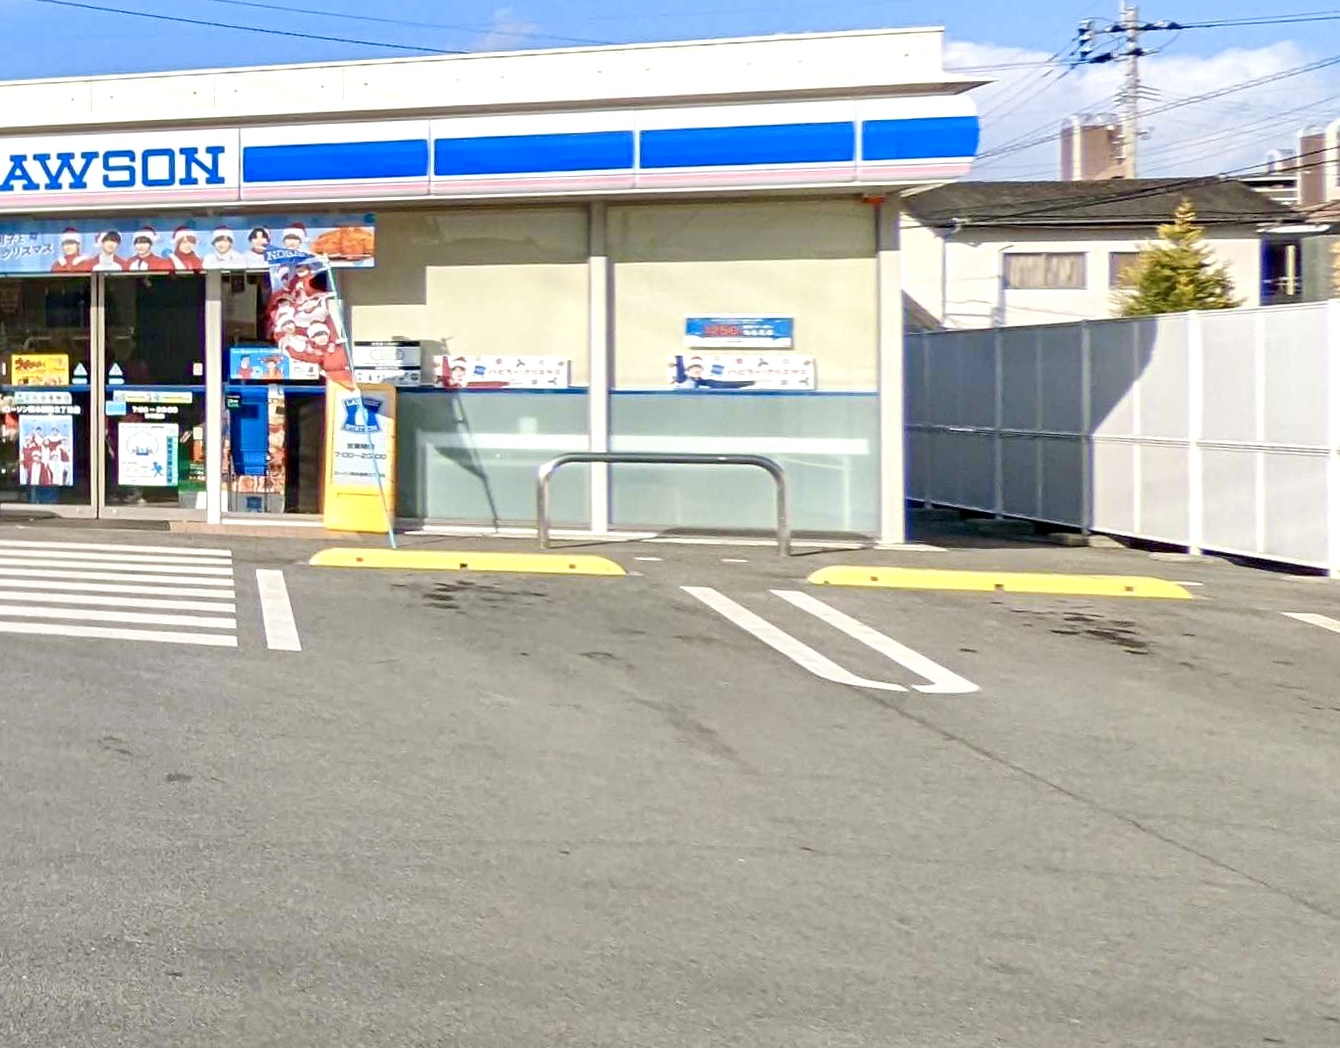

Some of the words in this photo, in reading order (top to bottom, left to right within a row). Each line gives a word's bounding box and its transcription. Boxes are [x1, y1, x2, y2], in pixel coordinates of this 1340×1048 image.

[2, 243, 54, 260] クリスマス
